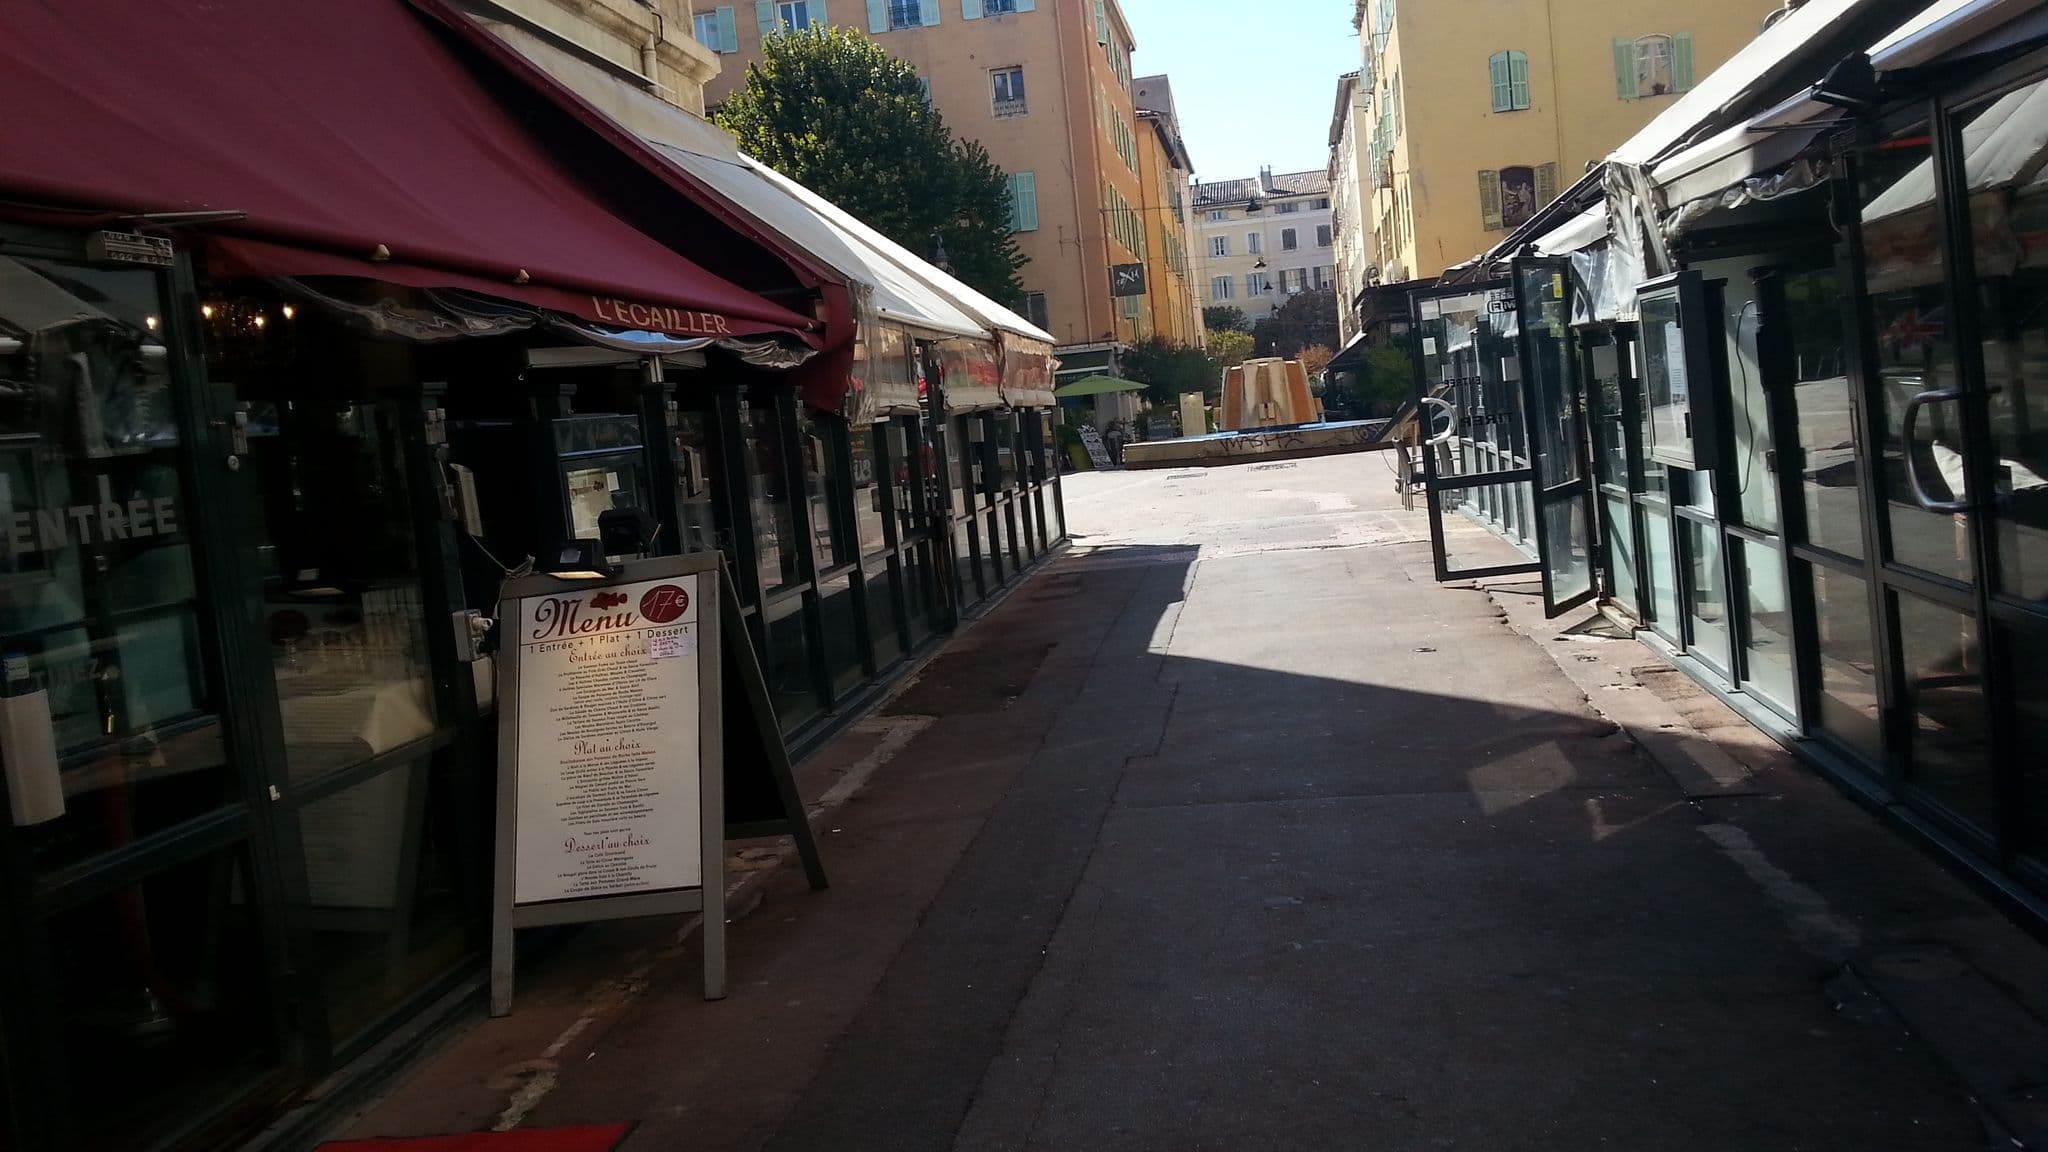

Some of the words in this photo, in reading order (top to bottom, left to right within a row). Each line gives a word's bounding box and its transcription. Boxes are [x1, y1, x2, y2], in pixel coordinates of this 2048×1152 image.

[9, 490, 177, 552] ENTRÉE
[533, 597, 639, 639] Menu
[540, 641, 573, 654] Entrée
[599, 635, 620, 645] Plat
[647, 625, 689, 638] Dessert
[605, 651, 616, 659] au
[620, 643, 647, 657] choix
[574, 740, 596, 755] Plat
[614, 737, 641, 751] choix
[565, 837, 604, 853] Dessert
[623, 833, 651, 847] choix
